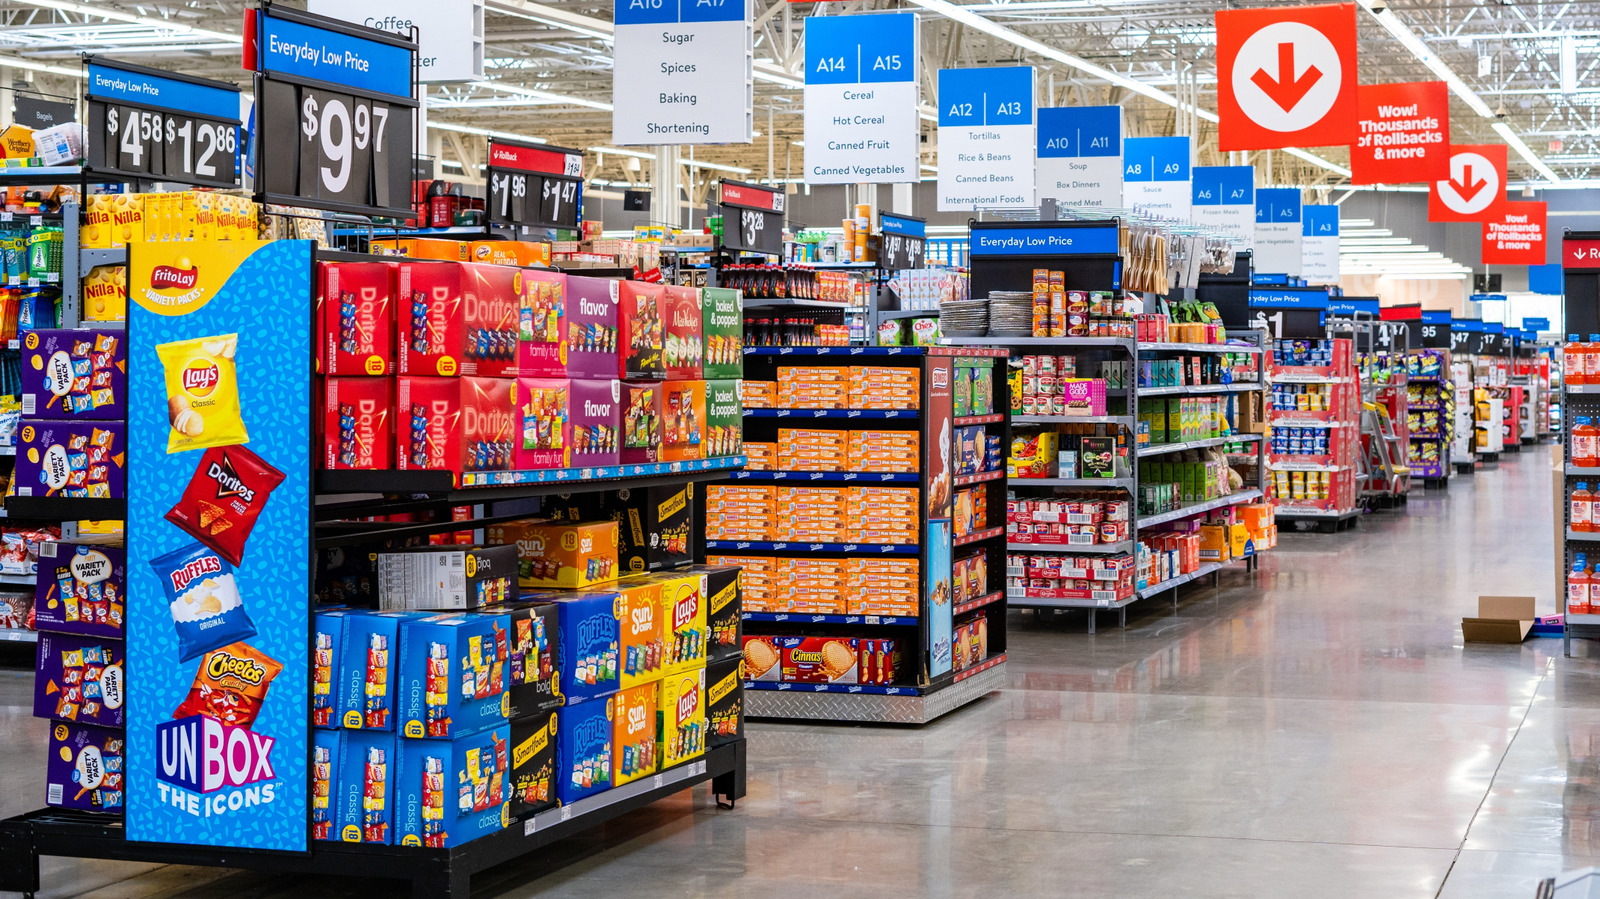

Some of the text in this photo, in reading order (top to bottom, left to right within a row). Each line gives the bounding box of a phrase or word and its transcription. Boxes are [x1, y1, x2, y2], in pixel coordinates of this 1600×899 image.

[364, 16, 413, 31] Coffee
[662, 32, 695, 45] Sugar
[270, 35, 369, 73] Everyday Low Price
[661, 62, 696, 76] Spices
[816, 57, 845, 73] A14
[873, 55, 901, 71] A15
[96, 74, 159, 96] Everyday Low Price
[659, 92, 697, 106] Baking
[843, 90, 874, 101] Cereal
[36, 111, 53, 121] Bagels
[949, 104, 972, 117] A12
[997, 102, 1021, 116] A13
[1378, 105, 1418, 118] Wow!
[833, 114, 885, 126] Hot Cereal
[1360, 117, 1439, 132] Thousands
[647, 121, 710, 136] Shortening
[969, 131, 1001, 141] Tortillas
[1091, 137, 1108, 148] A11
[1358, 131, 1443, 147] of Rollbacks
[828, 140, 890, 151] Canned Fruit
[1047, 138, 1068, 149] A10
[499, 150, 518, 162] Rollback
[958, 153, 1011, 162] Rice & Beans
[1373, 148, 1426, 160] & more
[814, 164, 905, 176] Canned Vegetables
[1069, 162, 1088, 172] Soup
[1126, 164, 1142, 175] A8
[1164, 164, 1179, 174] A9
[956, 174, 1014, 184] Canned Beans
[1056, 180, 1100, 190] Box Dinners
[945, 194, 1025, 206] International Foods
[1198, 190, 1212, 199] A6
[1231, 189, 1244, 198] A7
[114, 210, 142, 226] Nilla
[196, 212, 214, 226] Nilla
[1489, 223, 1540, 232] Thousands
[980, 236, 1074, 248] Everyday Low Price
[1487, 232, 1542, 242] of Rollbacks
[460, 245, 466, 254] 30
[1505, 242, 1530, 250] more
[86, 283, 115, 299] Nilla
[146, 288, 201, 306] VARIETY PACKS
[464, 293, 519, 324] Doritos
[580, 298, 609, 316] flavor
[716, 300, 734, 313] baked
[360, 287, 377, 354] Doritos
[432, 286, 449, 354] Doritos
[710, 312, 738, 328] & popped
[914, 322, 933, 331] Chex
[27, 334, 35, 347] 40
[530, 344, 560, 358] family fun
[54, 358, 64, 391] VARIETY
[60, 362, 70, 384] PACK
[185, 365, 218, 390] Lay's
[192, 398, 216, 409] Classic
[24, 427, 32, 440] 40
[50, 451, 60, 484] VARIETY
[208, 462, 255, 503] Doritos
[660, 495, 685, 518] Smartfood
[564, 533, 575, 545] 18
[76, 560, 106, 571] VARIETY
[477, 559, 492, 572] bold
[82, 568, 101, 578] PACK
[170, 555, 222, 593] RUFFLES
[712, 586, 736, 613] Smartfood
[675, 595, 698, 627] Lay's
[199, 617, 226, 631] ORIGINAL
[632, 603, 653, 635] Sun
[577, 615, 614, 651] RUFFLES
[640, 622, 652, 632] CHIPS
[790, 648, 822, 664] Cinnas
[208, 653, 265, 686] Cheetos
[352, 670, 361, 708] classic
[536, 678, 552, 692] bold
[411, 679, 420, 718] classic
[480, 700, 501, 717] classic
[678, 690, 698, 723] Lay's
[350, 715, 360, 726] 18
[628, 704, 647, 735] Sun
[411, 724, 422, 736] 18
[515, 728, 547, 765] Smartfood
[158, 782, 200, 817] THE
